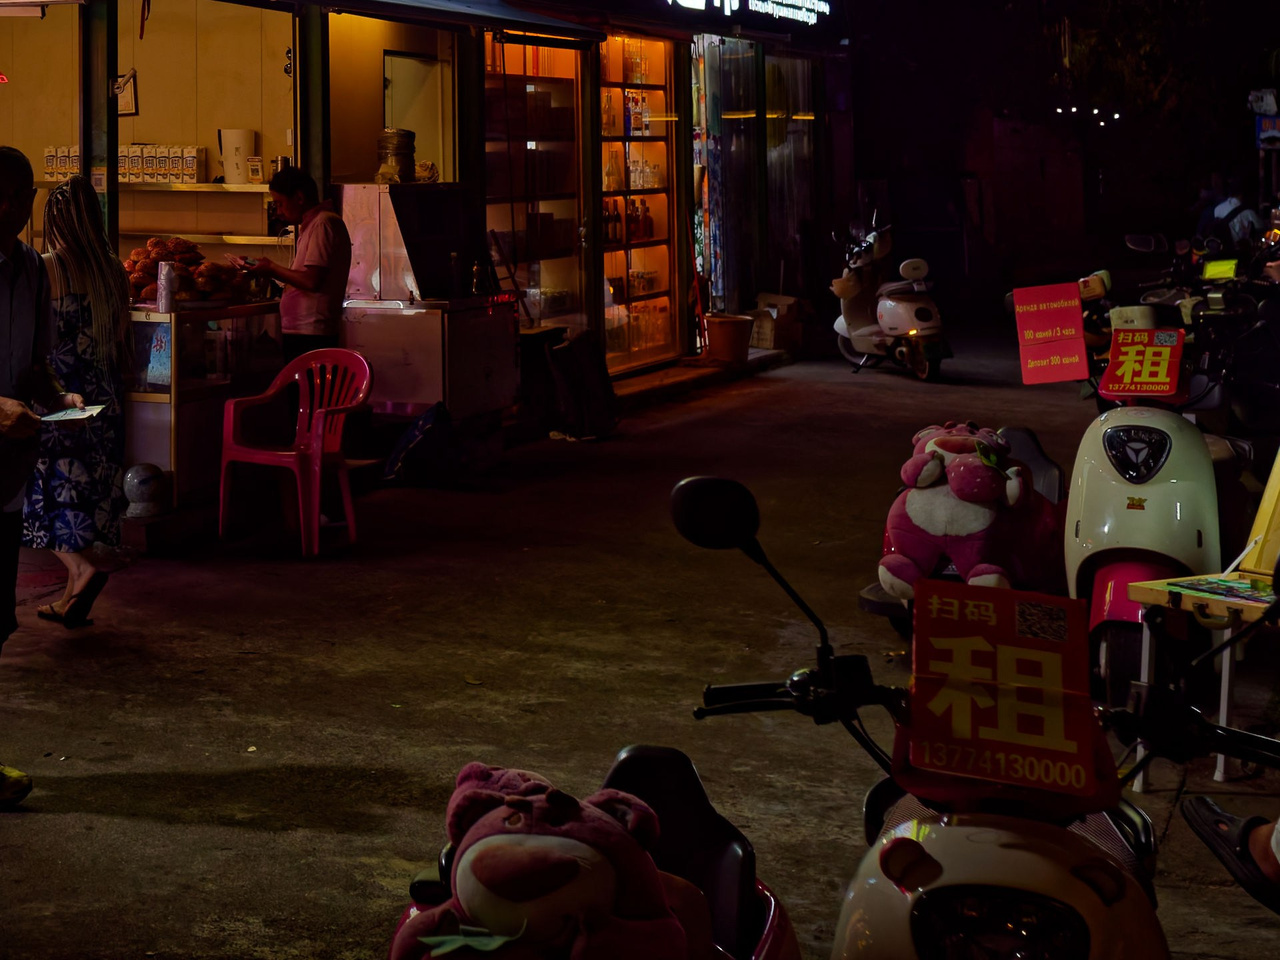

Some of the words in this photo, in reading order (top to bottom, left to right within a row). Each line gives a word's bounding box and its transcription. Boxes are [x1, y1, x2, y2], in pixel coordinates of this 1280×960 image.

[1039, 298, 1080, 312] автомобилей
[1117, 332, 1149, 344] 扫码
[1115, 343, 1172, 384] 租
[1108, 383, 1170, 392] 13774130000
[928, 594, 998, 627] 扫码
[926, 635, 1079, 754] 租
[920, 741, 1087, 789] 13774130000
